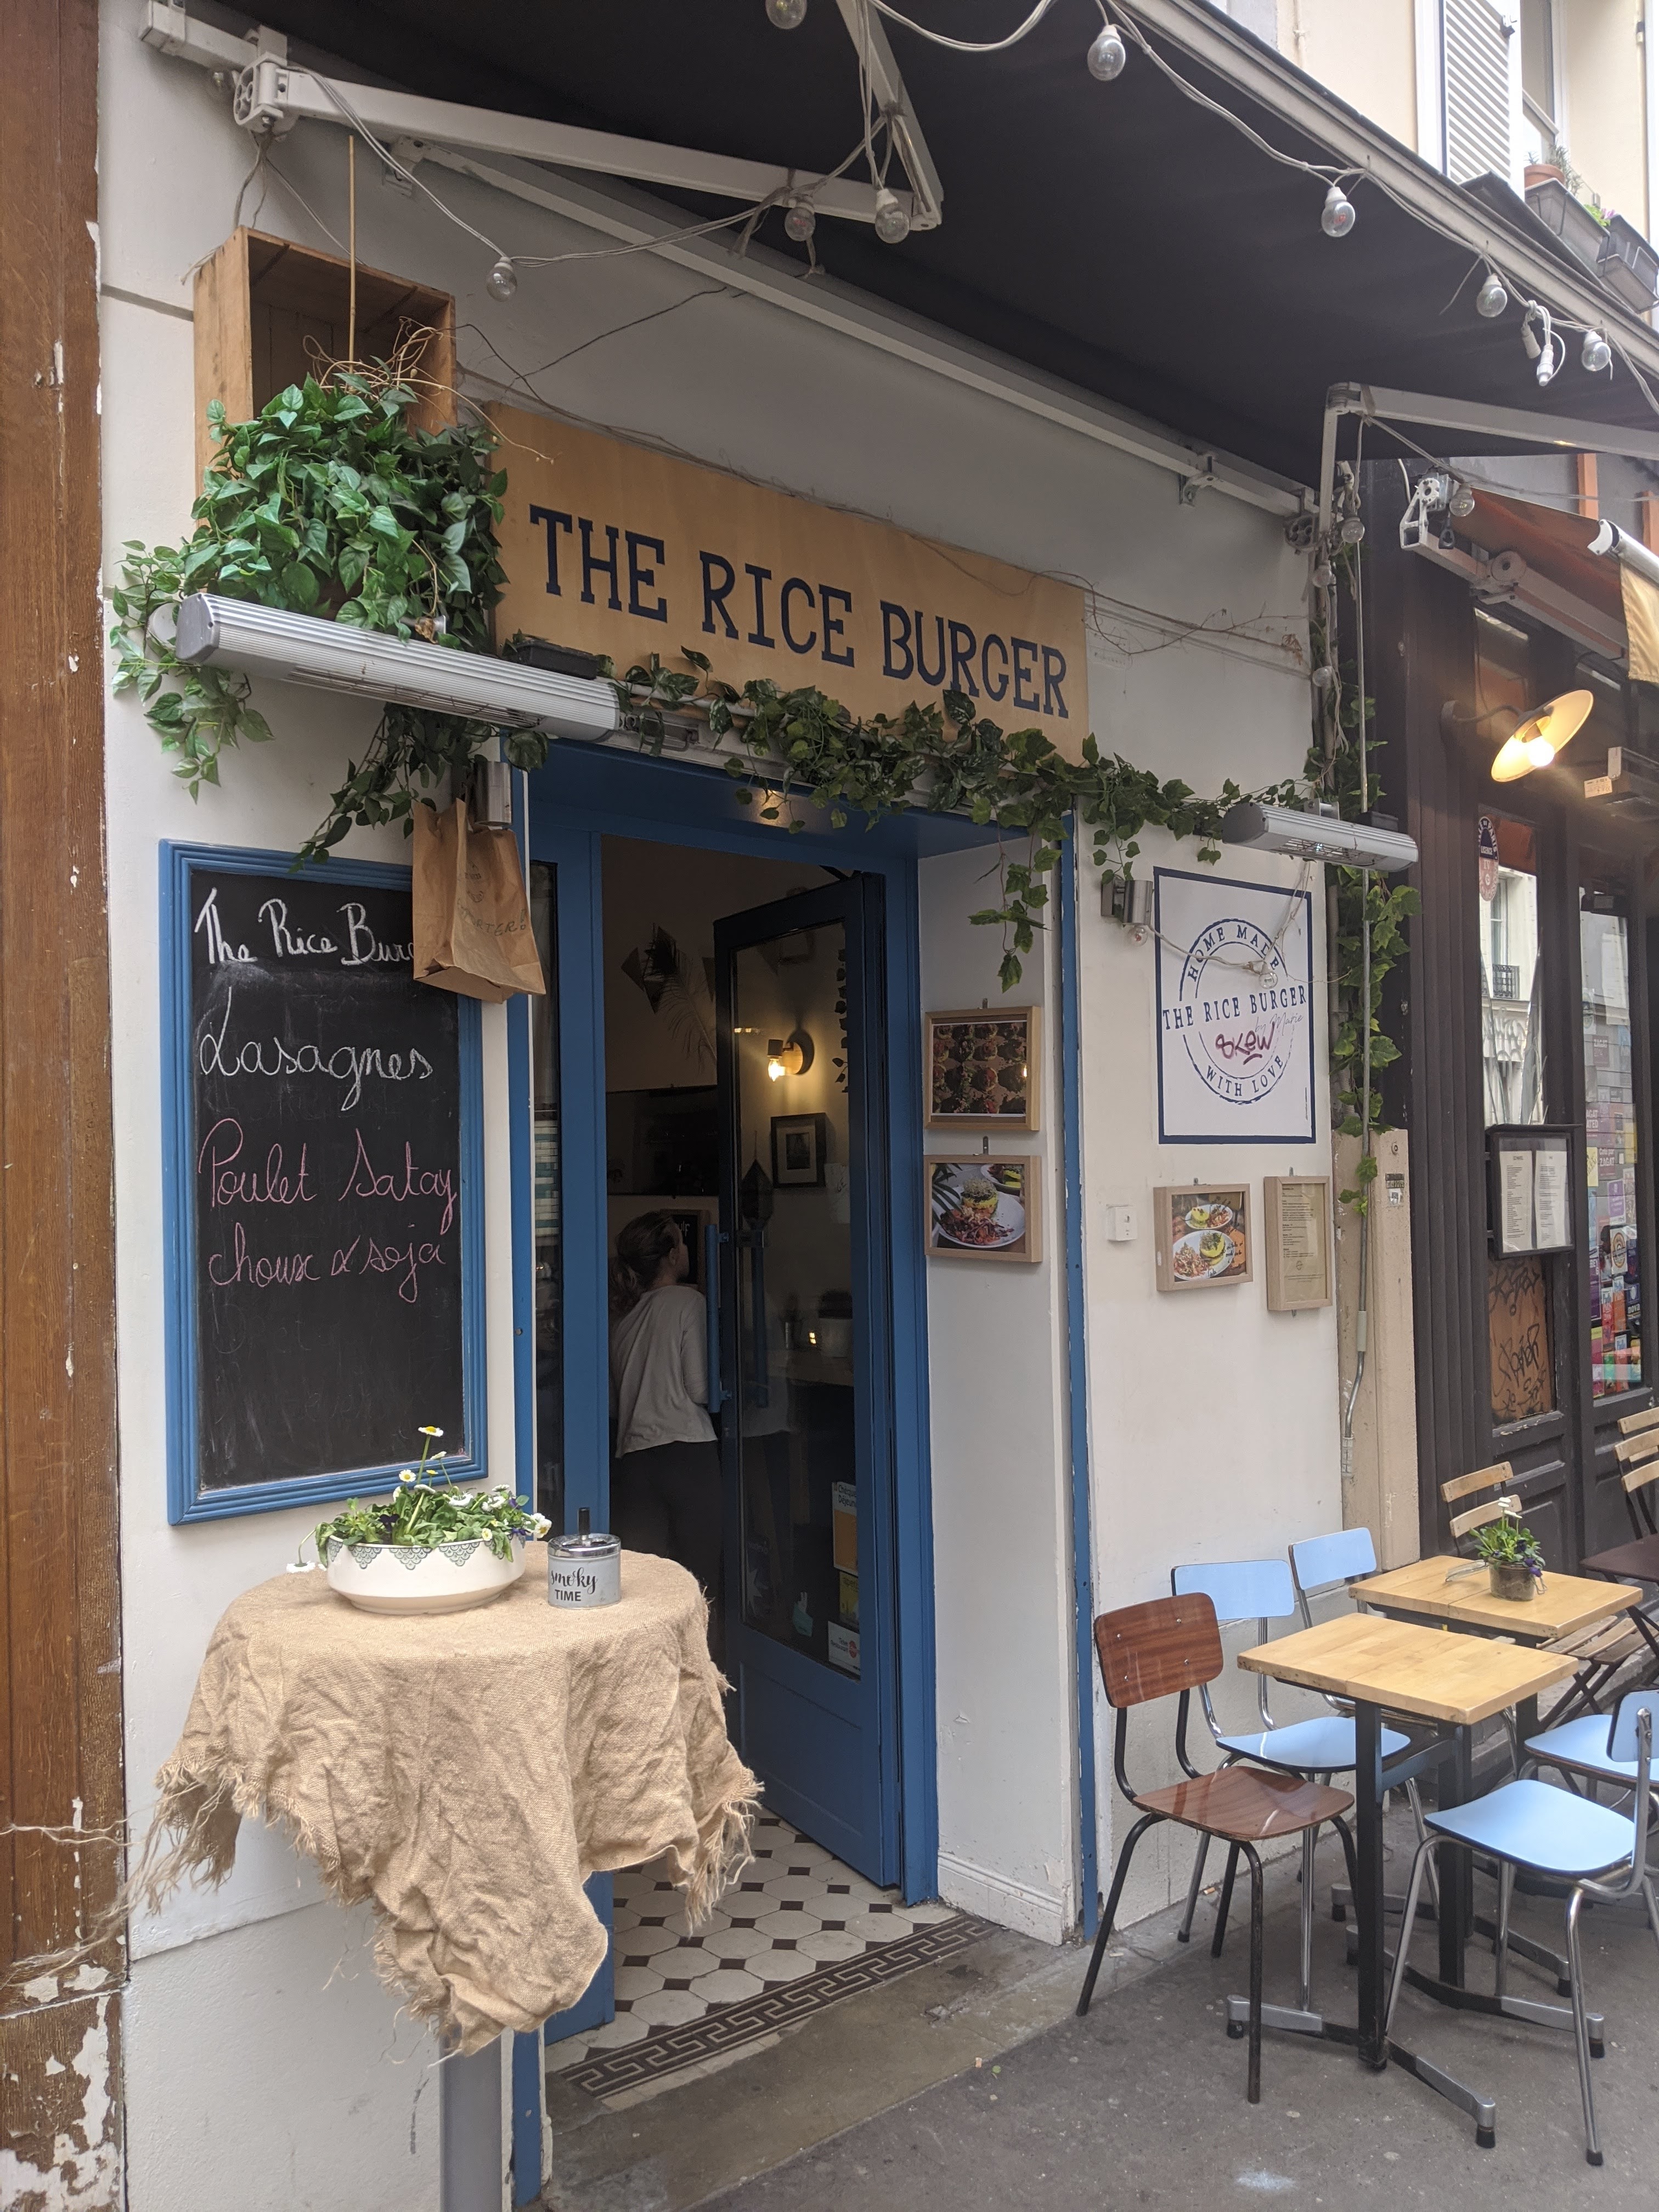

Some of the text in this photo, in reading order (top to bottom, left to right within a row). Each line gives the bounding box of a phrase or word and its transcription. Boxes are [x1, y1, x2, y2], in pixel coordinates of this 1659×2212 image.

[529, 504, 1069, 719] THE RICE BURGER
[195, 887, 257, 964] The
[258, 898, 338, 957] Rice
[1187, 924, 1279, 983] HOME MADE
[1162, 985, 1307, 1031] THE RICE BURGER
[1269, 1012, 1304, 1036] Marie
[199, 986, 433, 1111] Lasagnes
[1206, 1056, 1284, 1097] WITH LOVE
[198, 1118, 458, 1235] Poulet Satay
[1599, 1157, 1615, 1167] ZAGAT
[208, 1222, 321, 1288] choux
[358, 1223, 447, 1304] soja
[550, 1567, 598, 1594] smoky
[555, 1589, 582, 1601] TIME
